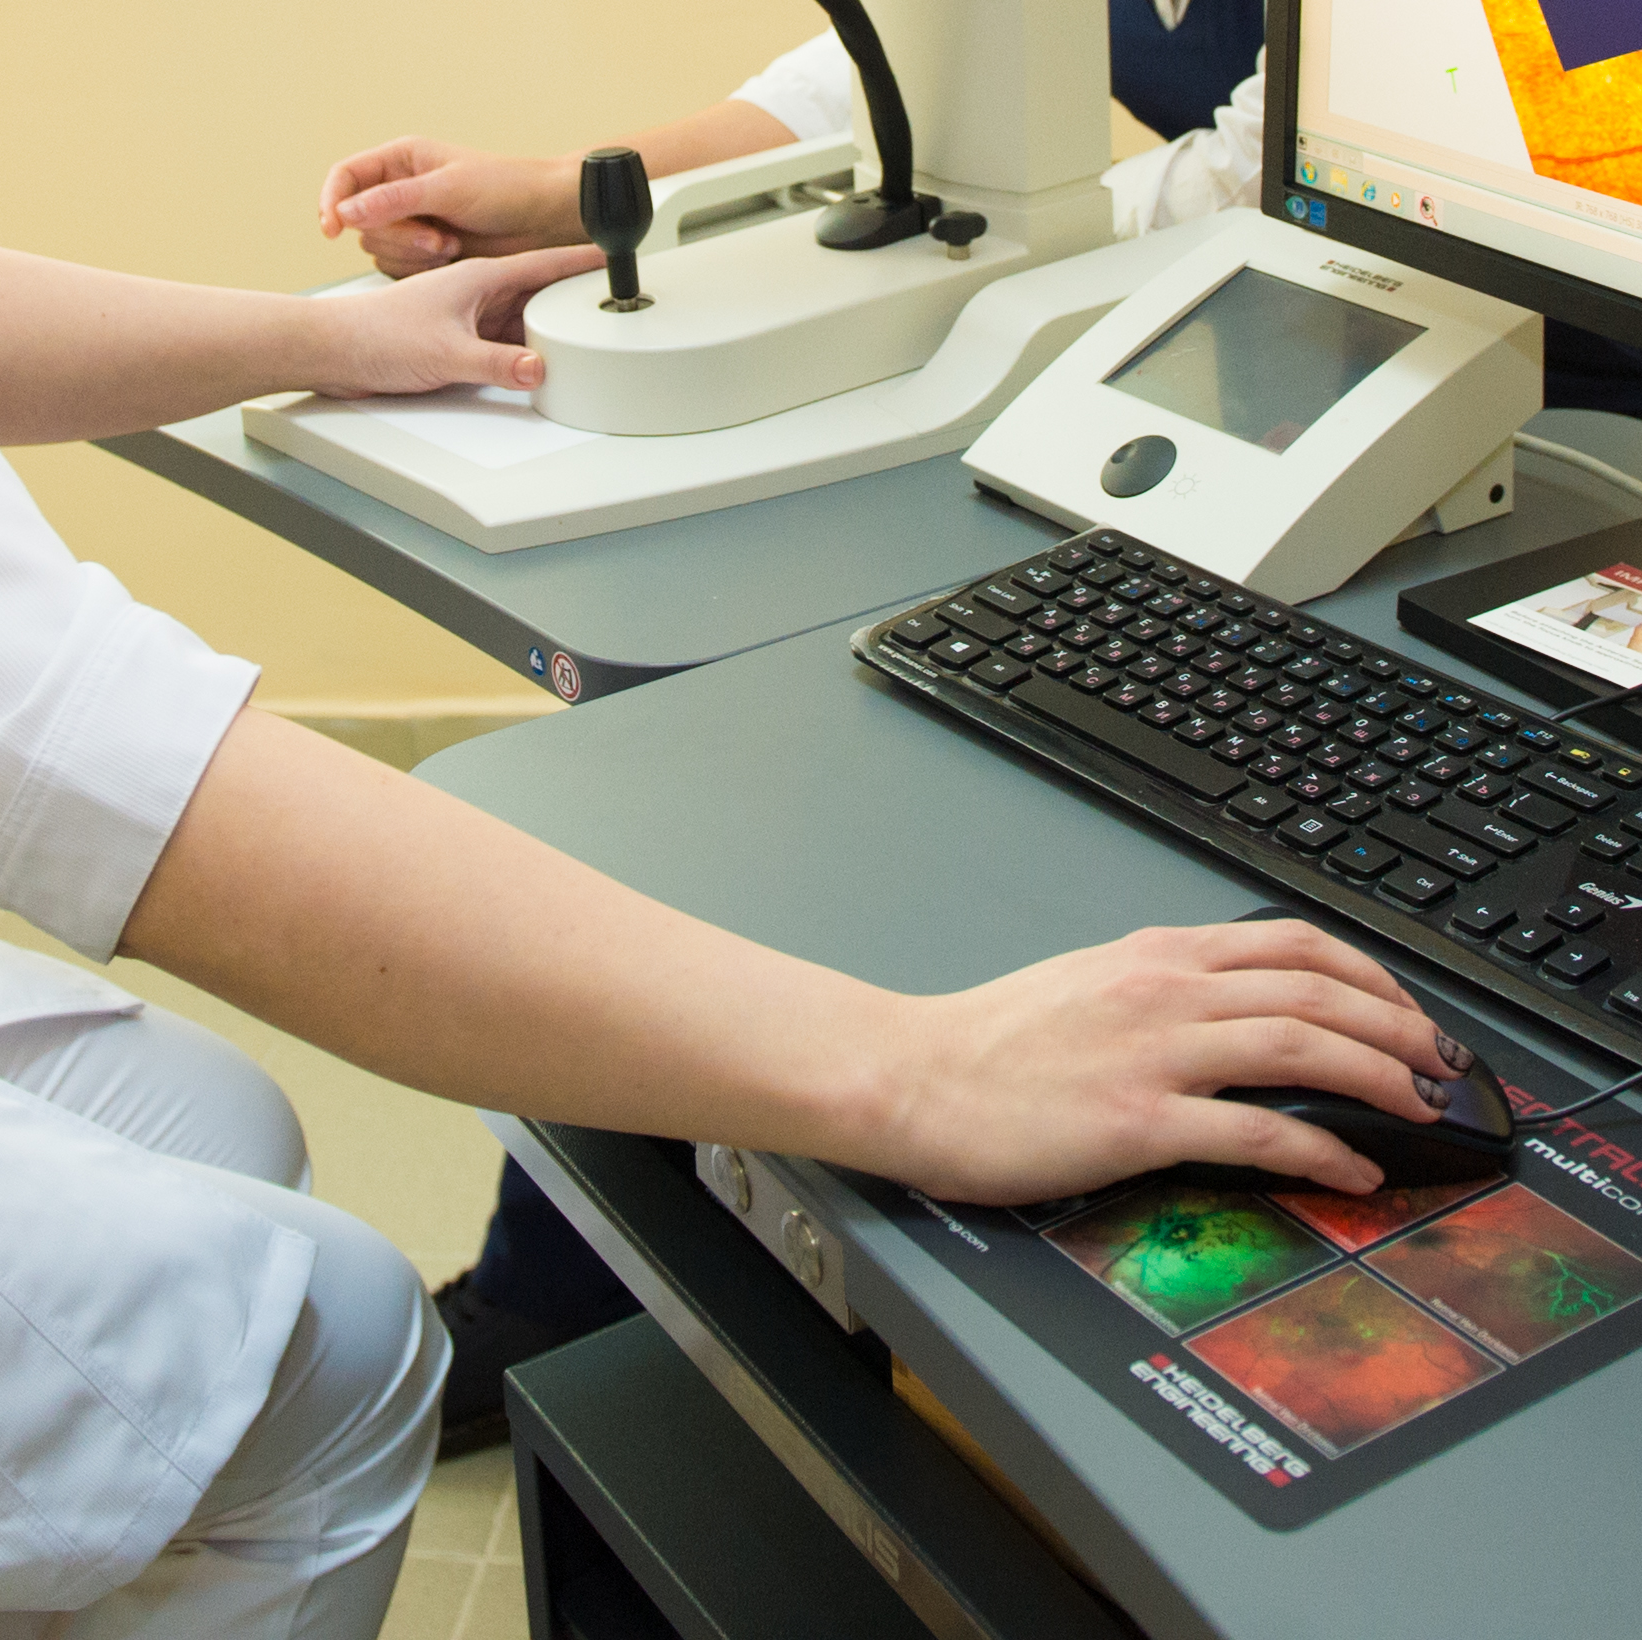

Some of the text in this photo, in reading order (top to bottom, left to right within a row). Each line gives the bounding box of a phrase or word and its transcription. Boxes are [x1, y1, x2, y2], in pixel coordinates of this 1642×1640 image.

[1074, 587, 1087, 596] Q
[1107, 603, 1123, 612] W
[1044, 609, 1057, 617] A
[1139, 618, 1153, 627] E
[1076, 624, 1090, 633] S
[1020, 634, 1035, 643] Z
[1173, 634, 1187, 643] R
[1108, 640, 1122, 649] D
[1255, 645, 1265, 653] 6
[1053, 650, 1068, 659] X
[1209, 650, 1223, 659] T
[1142, 656, 1157, 665] F
[1086, 667, 1100, 676] C
[1245, 666, 1257, 675] Y
[1178, 673, 1191, 682] G
[1121, 683, 1135, 692] V
[1279, 684, 1294, 693] U
[1213, 689, 1228, 699] H
[1455, 694, 1472, 704] F10
[1155, 700, 1169, 709] B
[1249, 709, 1263, 717] J
[1403, 713, 1415, 721] 0
[1496, 712, 1511, 721] F11
[1190, 717, 1205, 727] N
[1355, 719, 1369, 727] O
[1286, 725, 1302, 735] K
[1537, 730, 1555, 740] F12
[1227, 735, 1244, 746] M
[1393, 736, 1408, 745] P
[1324, 743, 1336, 753] L
[1556, 776, 1599, 799] Backspace
[1253, 796, 1268, 806] Alt
[1495, 828, 1519, 843] Enter
[1594, 833, 1623, 849] Delete
[1457, 852, 1479, 866] Shift
[1416, 877, 1435, 889] Ctrl
[1577, 882, 1625, 907] Genius
[1623, 990, 1640, 1003] Ins
[1129, 1359, 1277, 1475] ENGINEERING
[1161, 1362, 1312, 1479] HEIDELBERG
